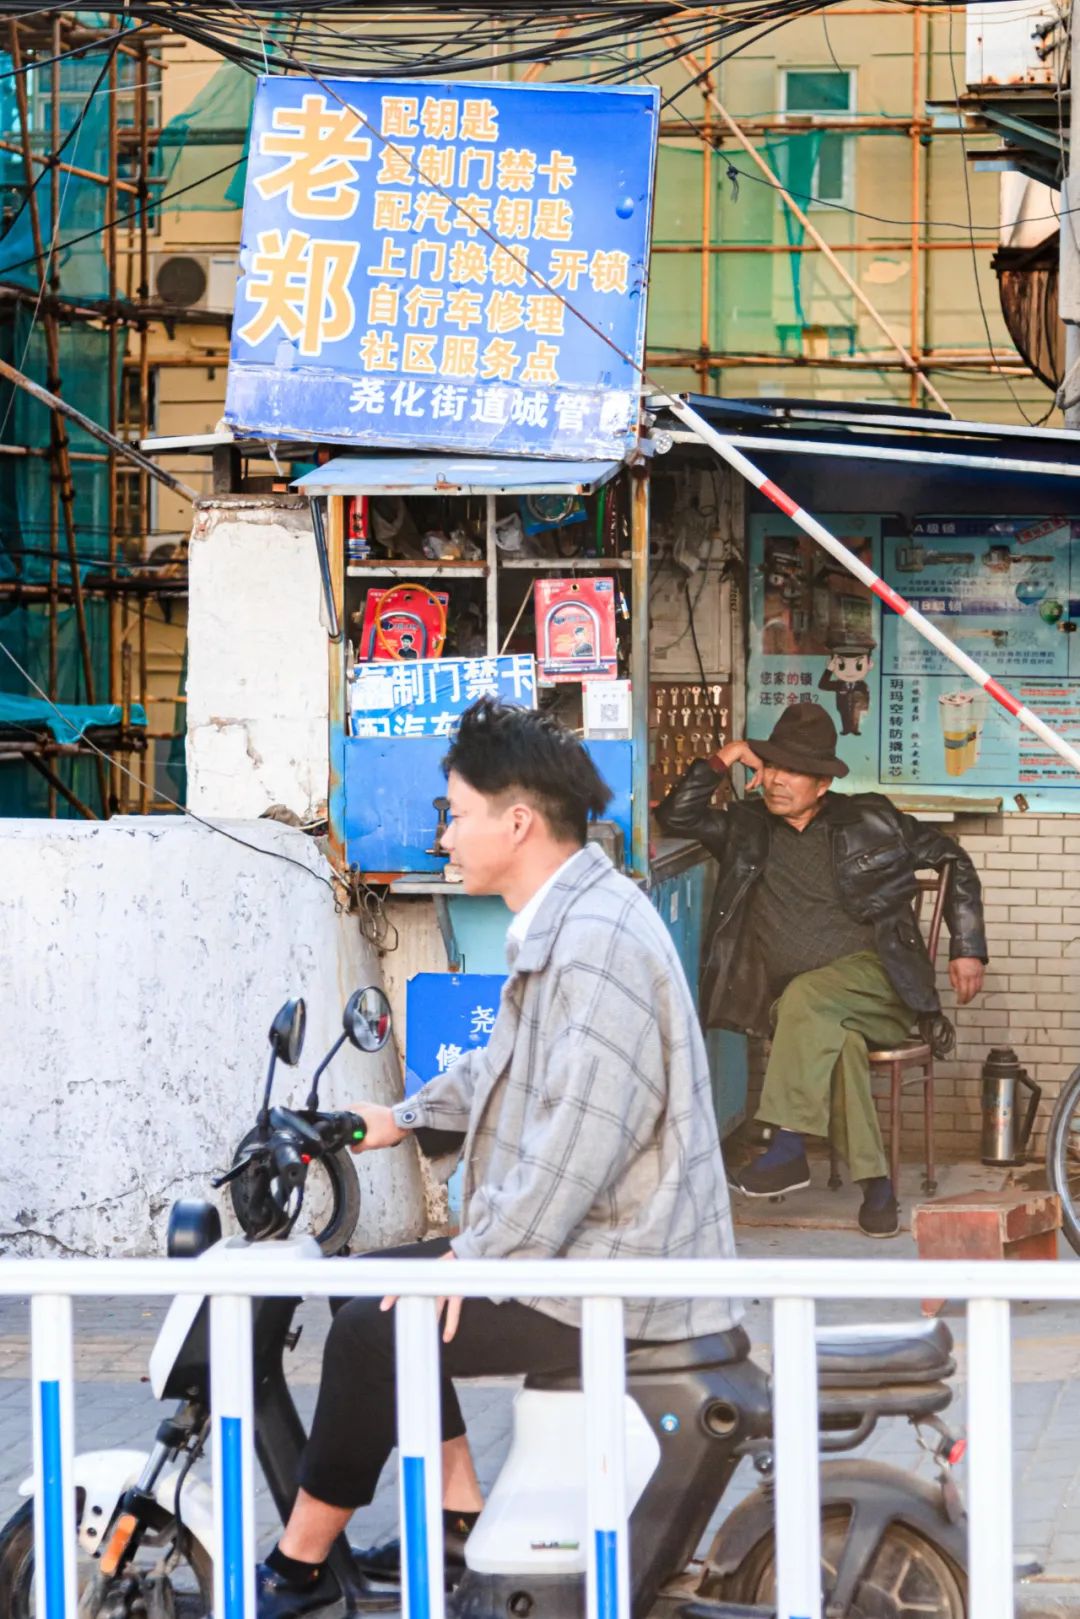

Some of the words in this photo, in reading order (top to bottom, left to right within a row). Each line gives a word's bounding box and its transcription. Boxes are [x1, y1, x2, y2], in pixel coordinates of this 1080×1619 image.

[381, 96, 499, 141] 配钥匙
[376, 145, 576, 194] 复制门禁卡
[238, 94, 373, 357] 老郑
[373, 191, 572, 241] 配汽车钥匙
[367, 239, 629, 294] 上门换锁、开锁
[367, 287, 566, 336] 自行车修理
[360, 332, 560, 386] 社区服务点
[349, 377, 631, 433] 尧化街道城管
[359, 655, 532, 707] 制门禁卡
